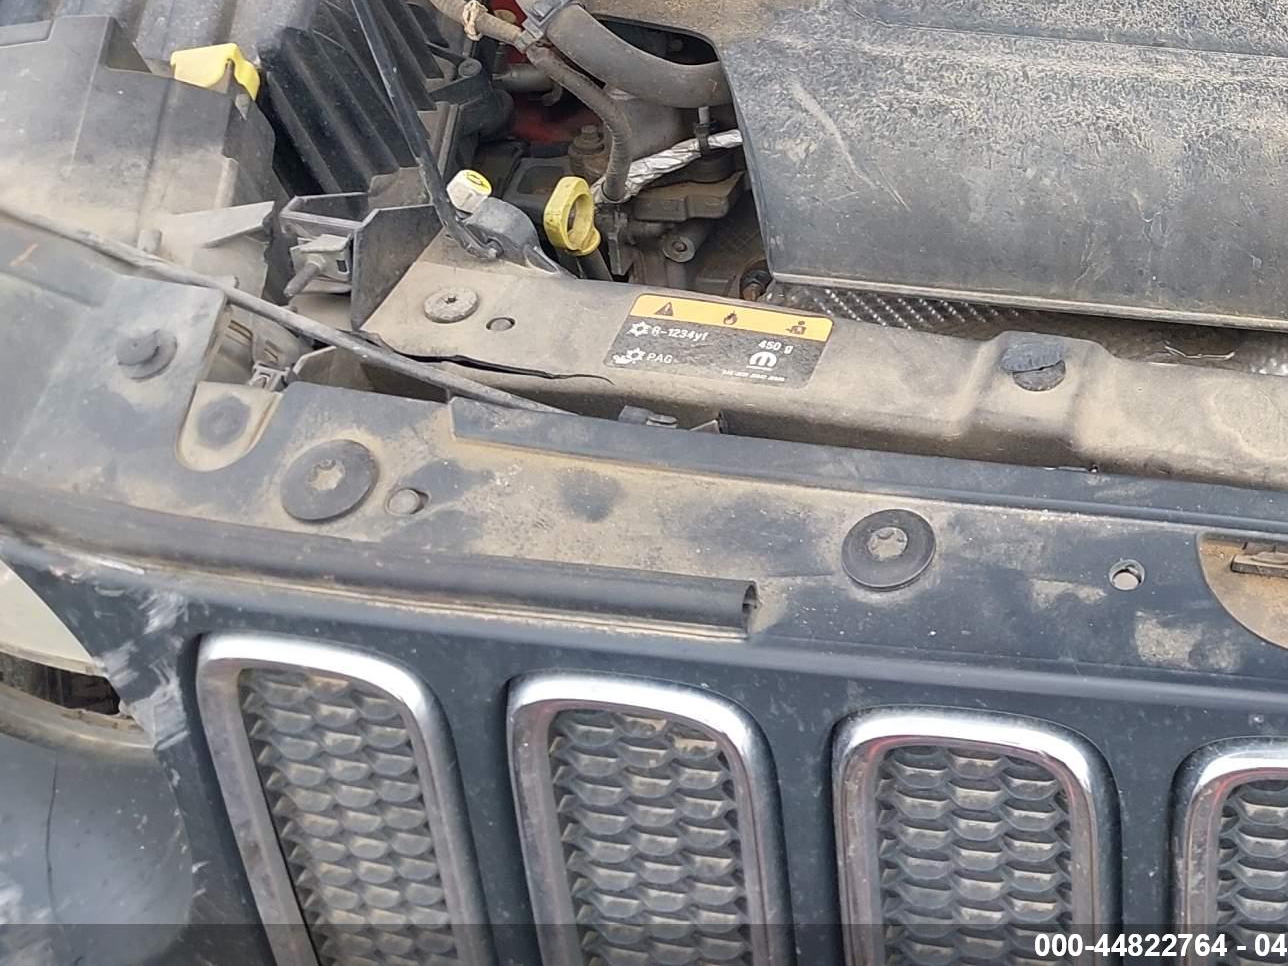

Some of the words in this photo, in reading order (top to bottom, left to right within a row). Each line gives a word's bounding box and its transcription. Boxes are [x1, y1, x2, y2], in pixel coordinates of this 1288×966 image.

[652, 328, 708, 342] R-1234yf
[758, 340, 781, 352] 450
[784, 345, 793, 355] g
[646, 352, 673, 364] PAG
